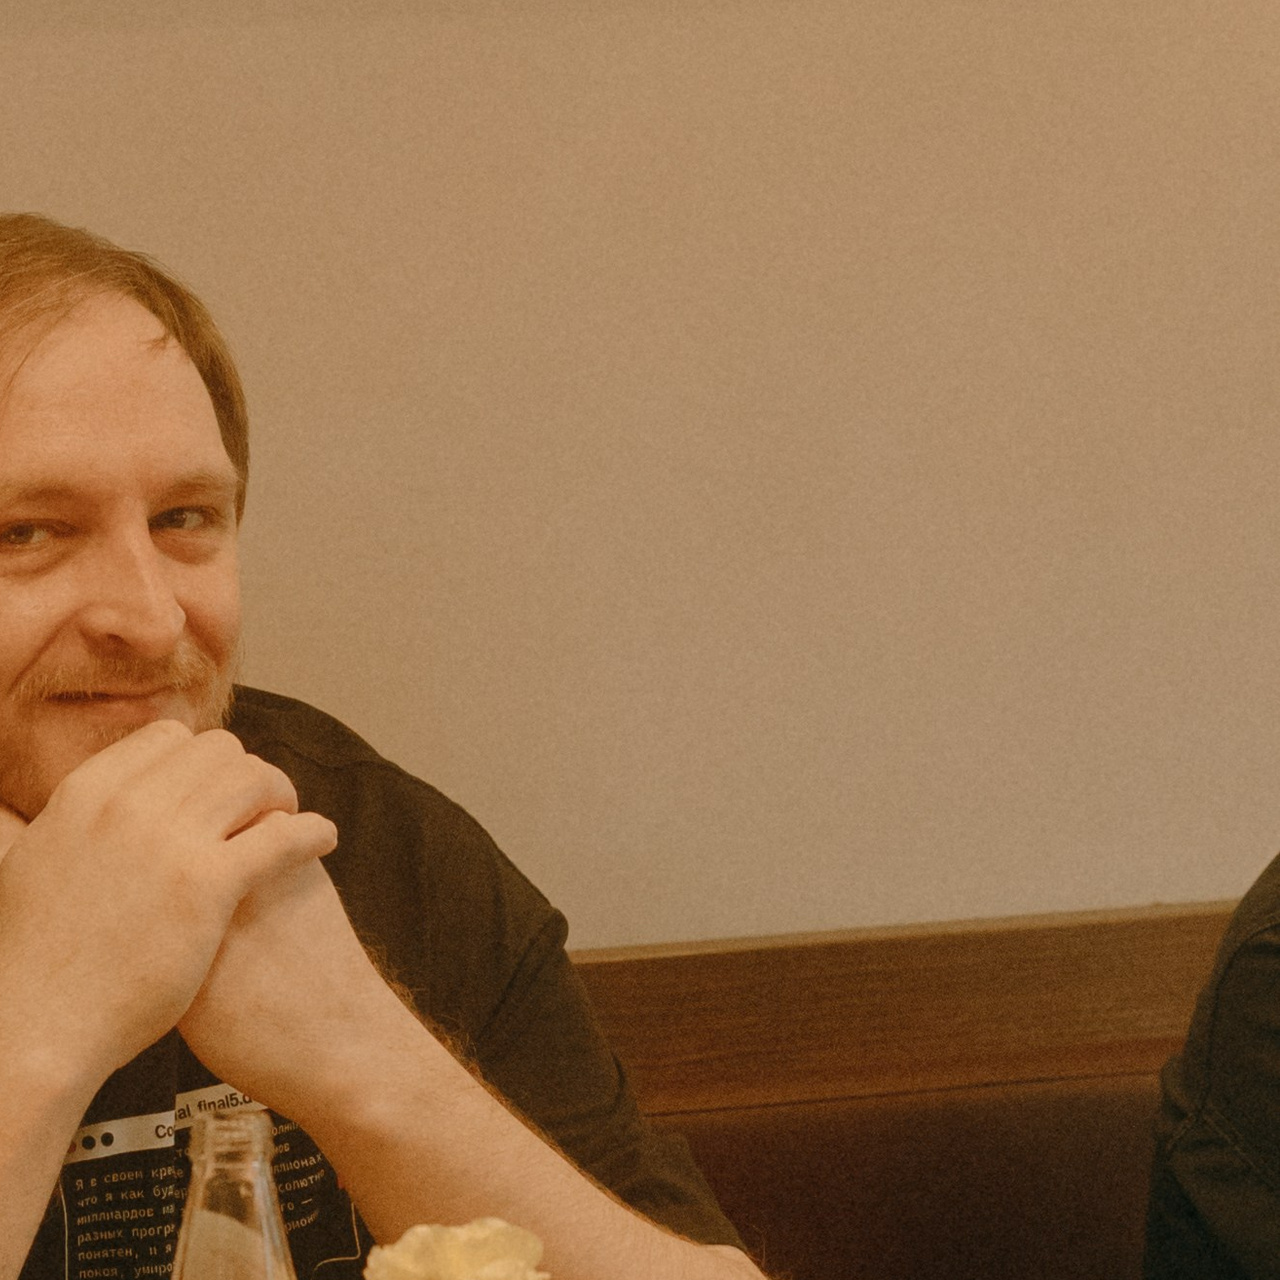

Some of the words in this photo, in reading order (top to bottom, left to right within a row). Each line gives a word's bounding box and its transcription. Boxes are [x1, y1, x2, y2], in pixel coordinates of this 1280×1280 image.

[78, 1194, 98, 1208] что
[121, 1189, 145, 1200] как
[77, 1207, 155, 1226] миллиардов
[77, 1228, 124, 1247] разных
